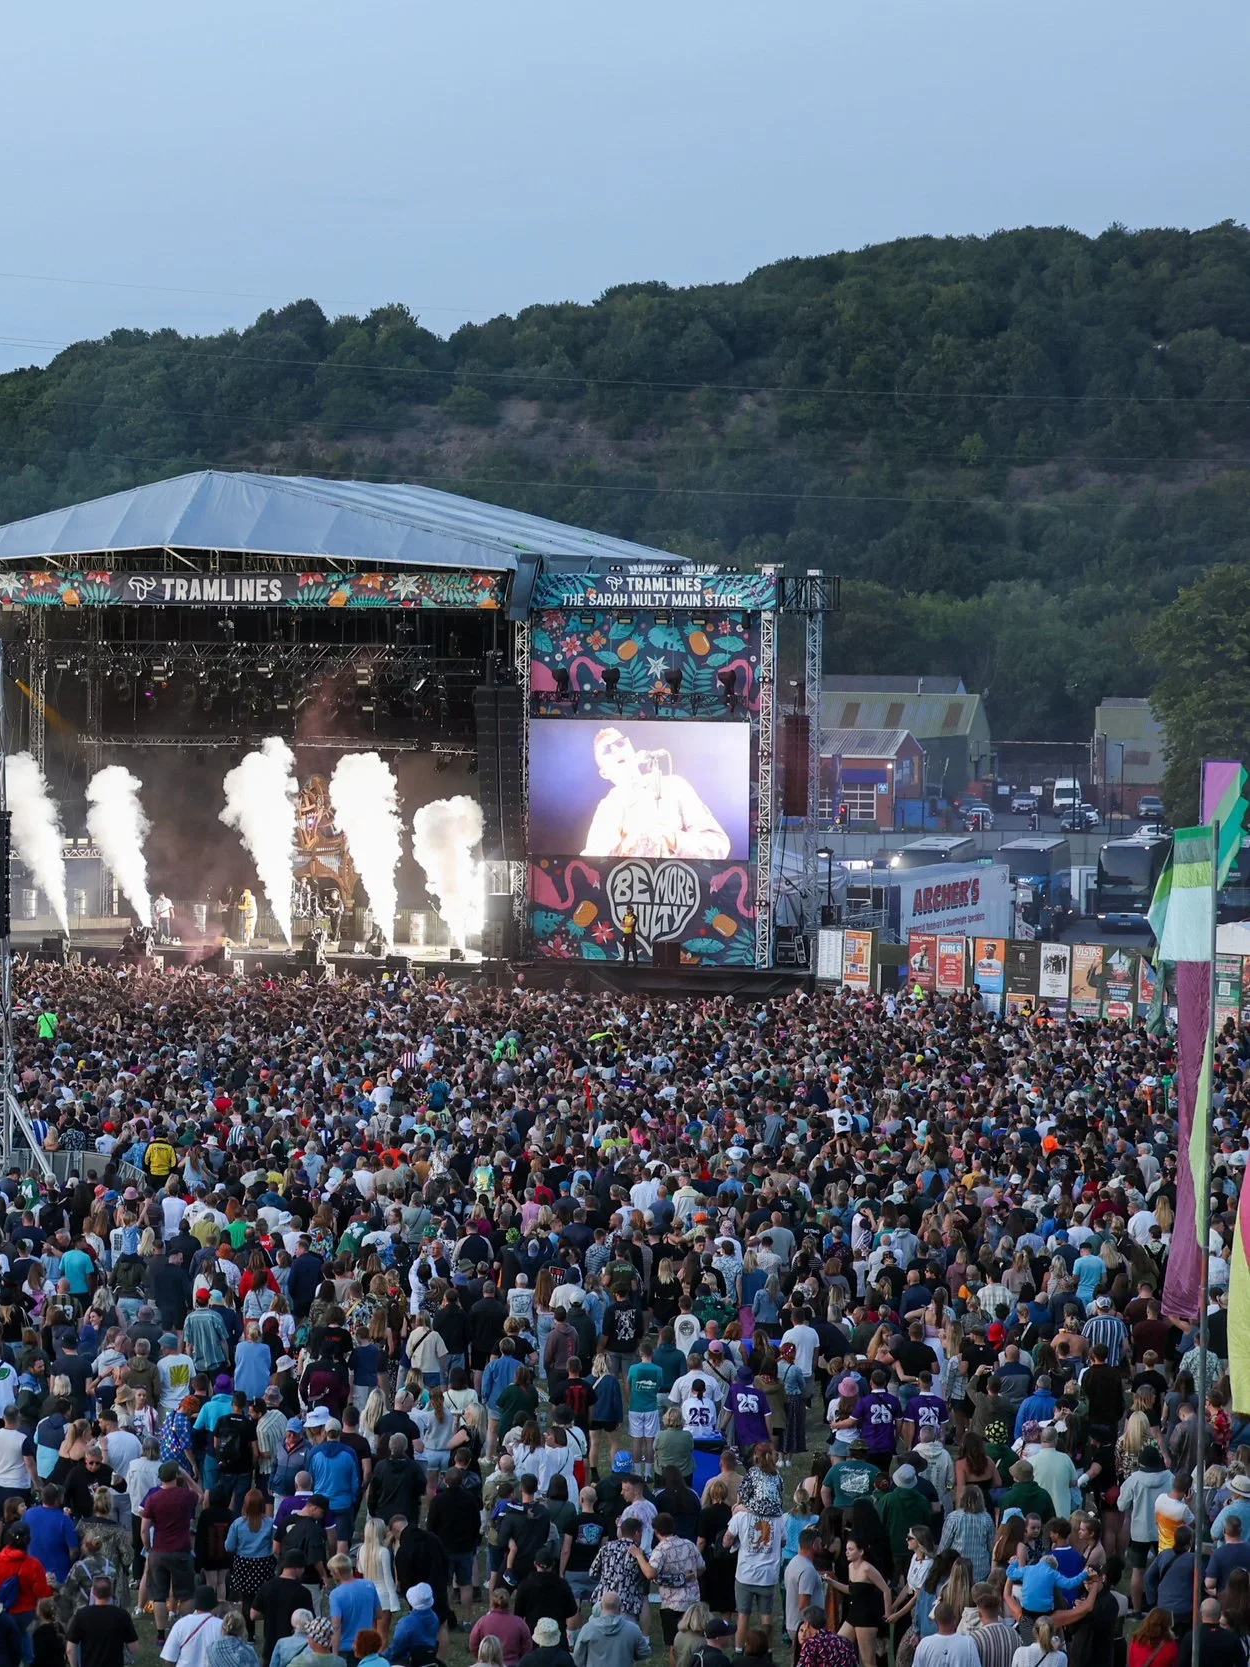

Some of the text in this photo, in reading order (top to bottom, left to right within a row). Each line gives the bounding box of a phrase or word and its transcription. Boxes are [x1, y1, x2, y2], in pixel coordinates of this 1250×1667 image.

[161, 578, 282, 602] TRAMLINES
[626, 577, 702, 592] TRAMLINES
[562, 593, 743, 608] THE SARAH NULTY MAIN STAGE
[613, 865, 695, 906] BE MORE
[912, 878, 980, 917] ARCHER'S
[940, 944, 962, 954] GIRLS
[1075, 947, 1102, 956] VISTAS
[737, 1393, 759, 1413] 25
[688, 1407, 710, 1426] 25
